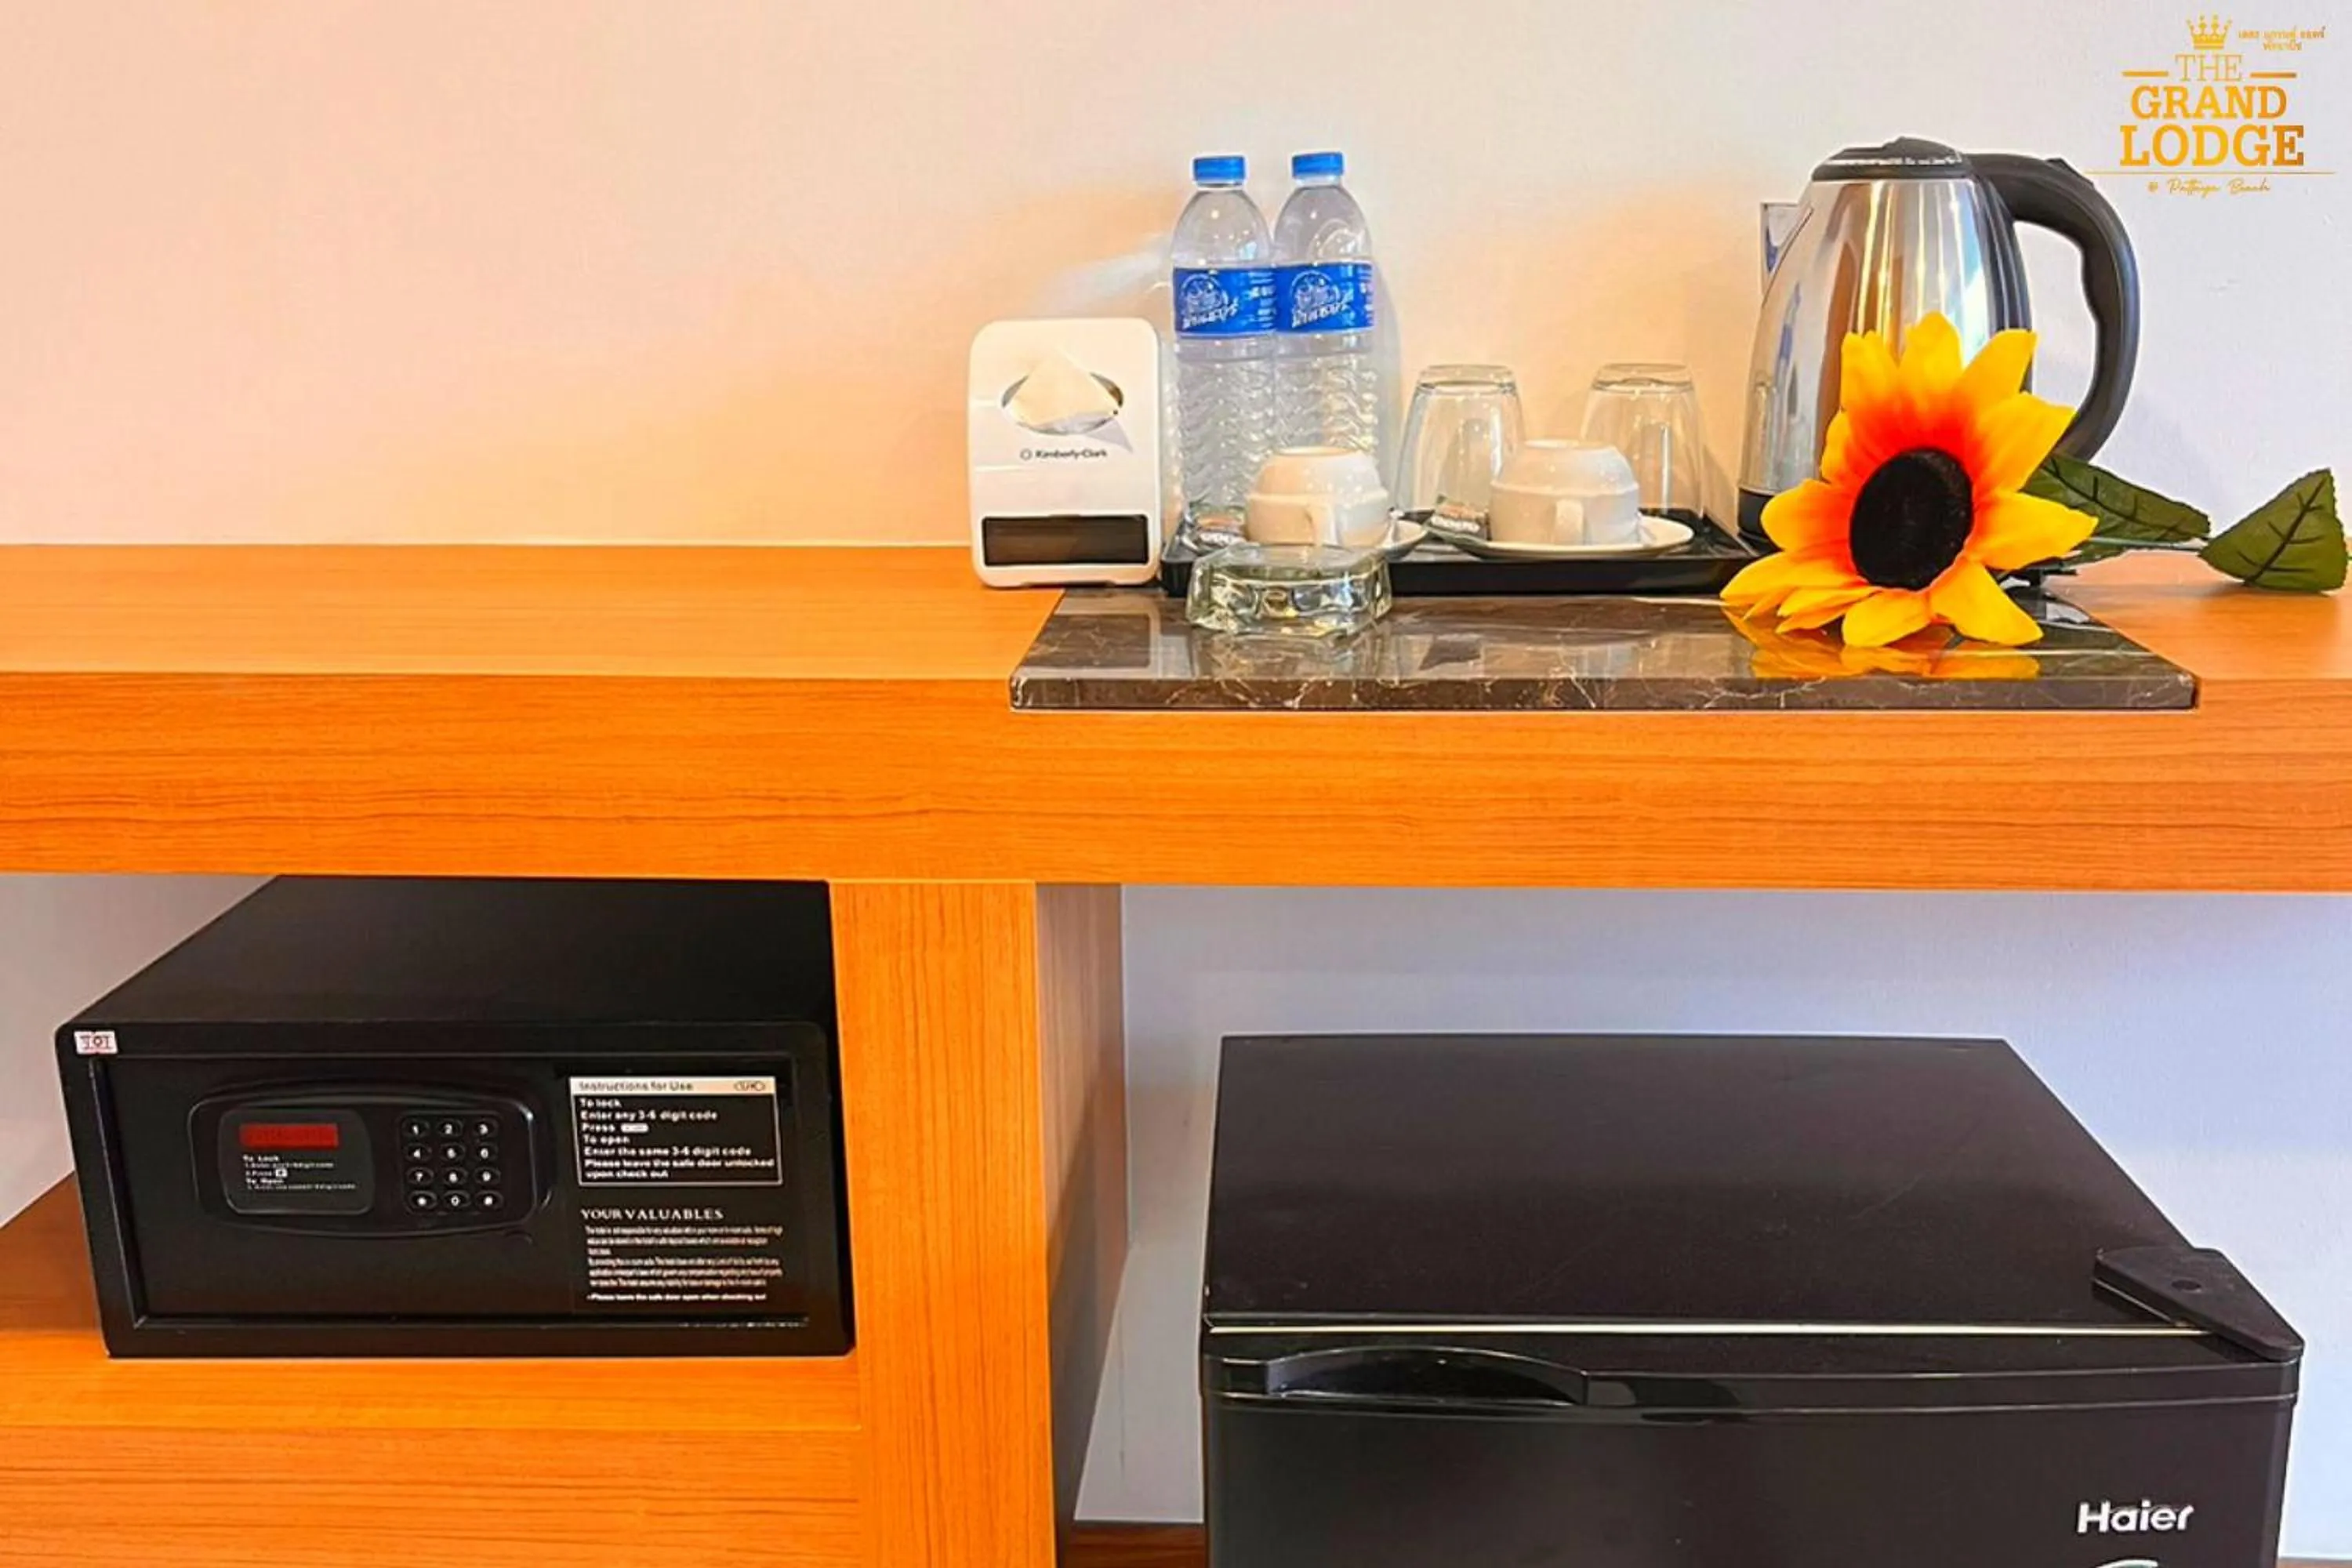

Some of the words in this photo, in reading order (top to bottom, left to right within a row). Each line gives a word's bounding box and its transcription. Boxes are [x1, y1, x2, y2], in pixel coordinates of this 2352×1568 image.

[1035, 448, 1108, 460] Kimberly-Clark
[579, 1081, 648, 1092] Instructions
[650, 1081, 667, 1091] for
[670, 1081, 693, 1091] Use
[580, 1098, 594, 1108] To
[581, 1110, 612, 1120] Enter
[615, 1112, 637, 1122] any
[660, 1110, 687, 1122] digit
[689, 1110, 717, 1120] code
[583, 1123, 615, 1132] Press
[583, 1134, 597, 1144] To
[600, 1136, 630, 1145] open
[584, 1146, 615, 1156] Enter
[617, 1146, 637, 1156] the
[638, 1147, 670, 1156] same
[692, 1146, 720, 1157] digit
[722, 1146, 752, 1156] code
[585, 1159, 620, 1167] Please
[622, 1159, 651, 1167] leave
[652, 1159, 670, 1167] the
[724, 1159, 775, 1167] unlocked
[580, 1208, 622, 1219] YOUR
[625, 1208, 724, 1220] VALUABLES
[2078, 1498, 2194, 1534] Haier
